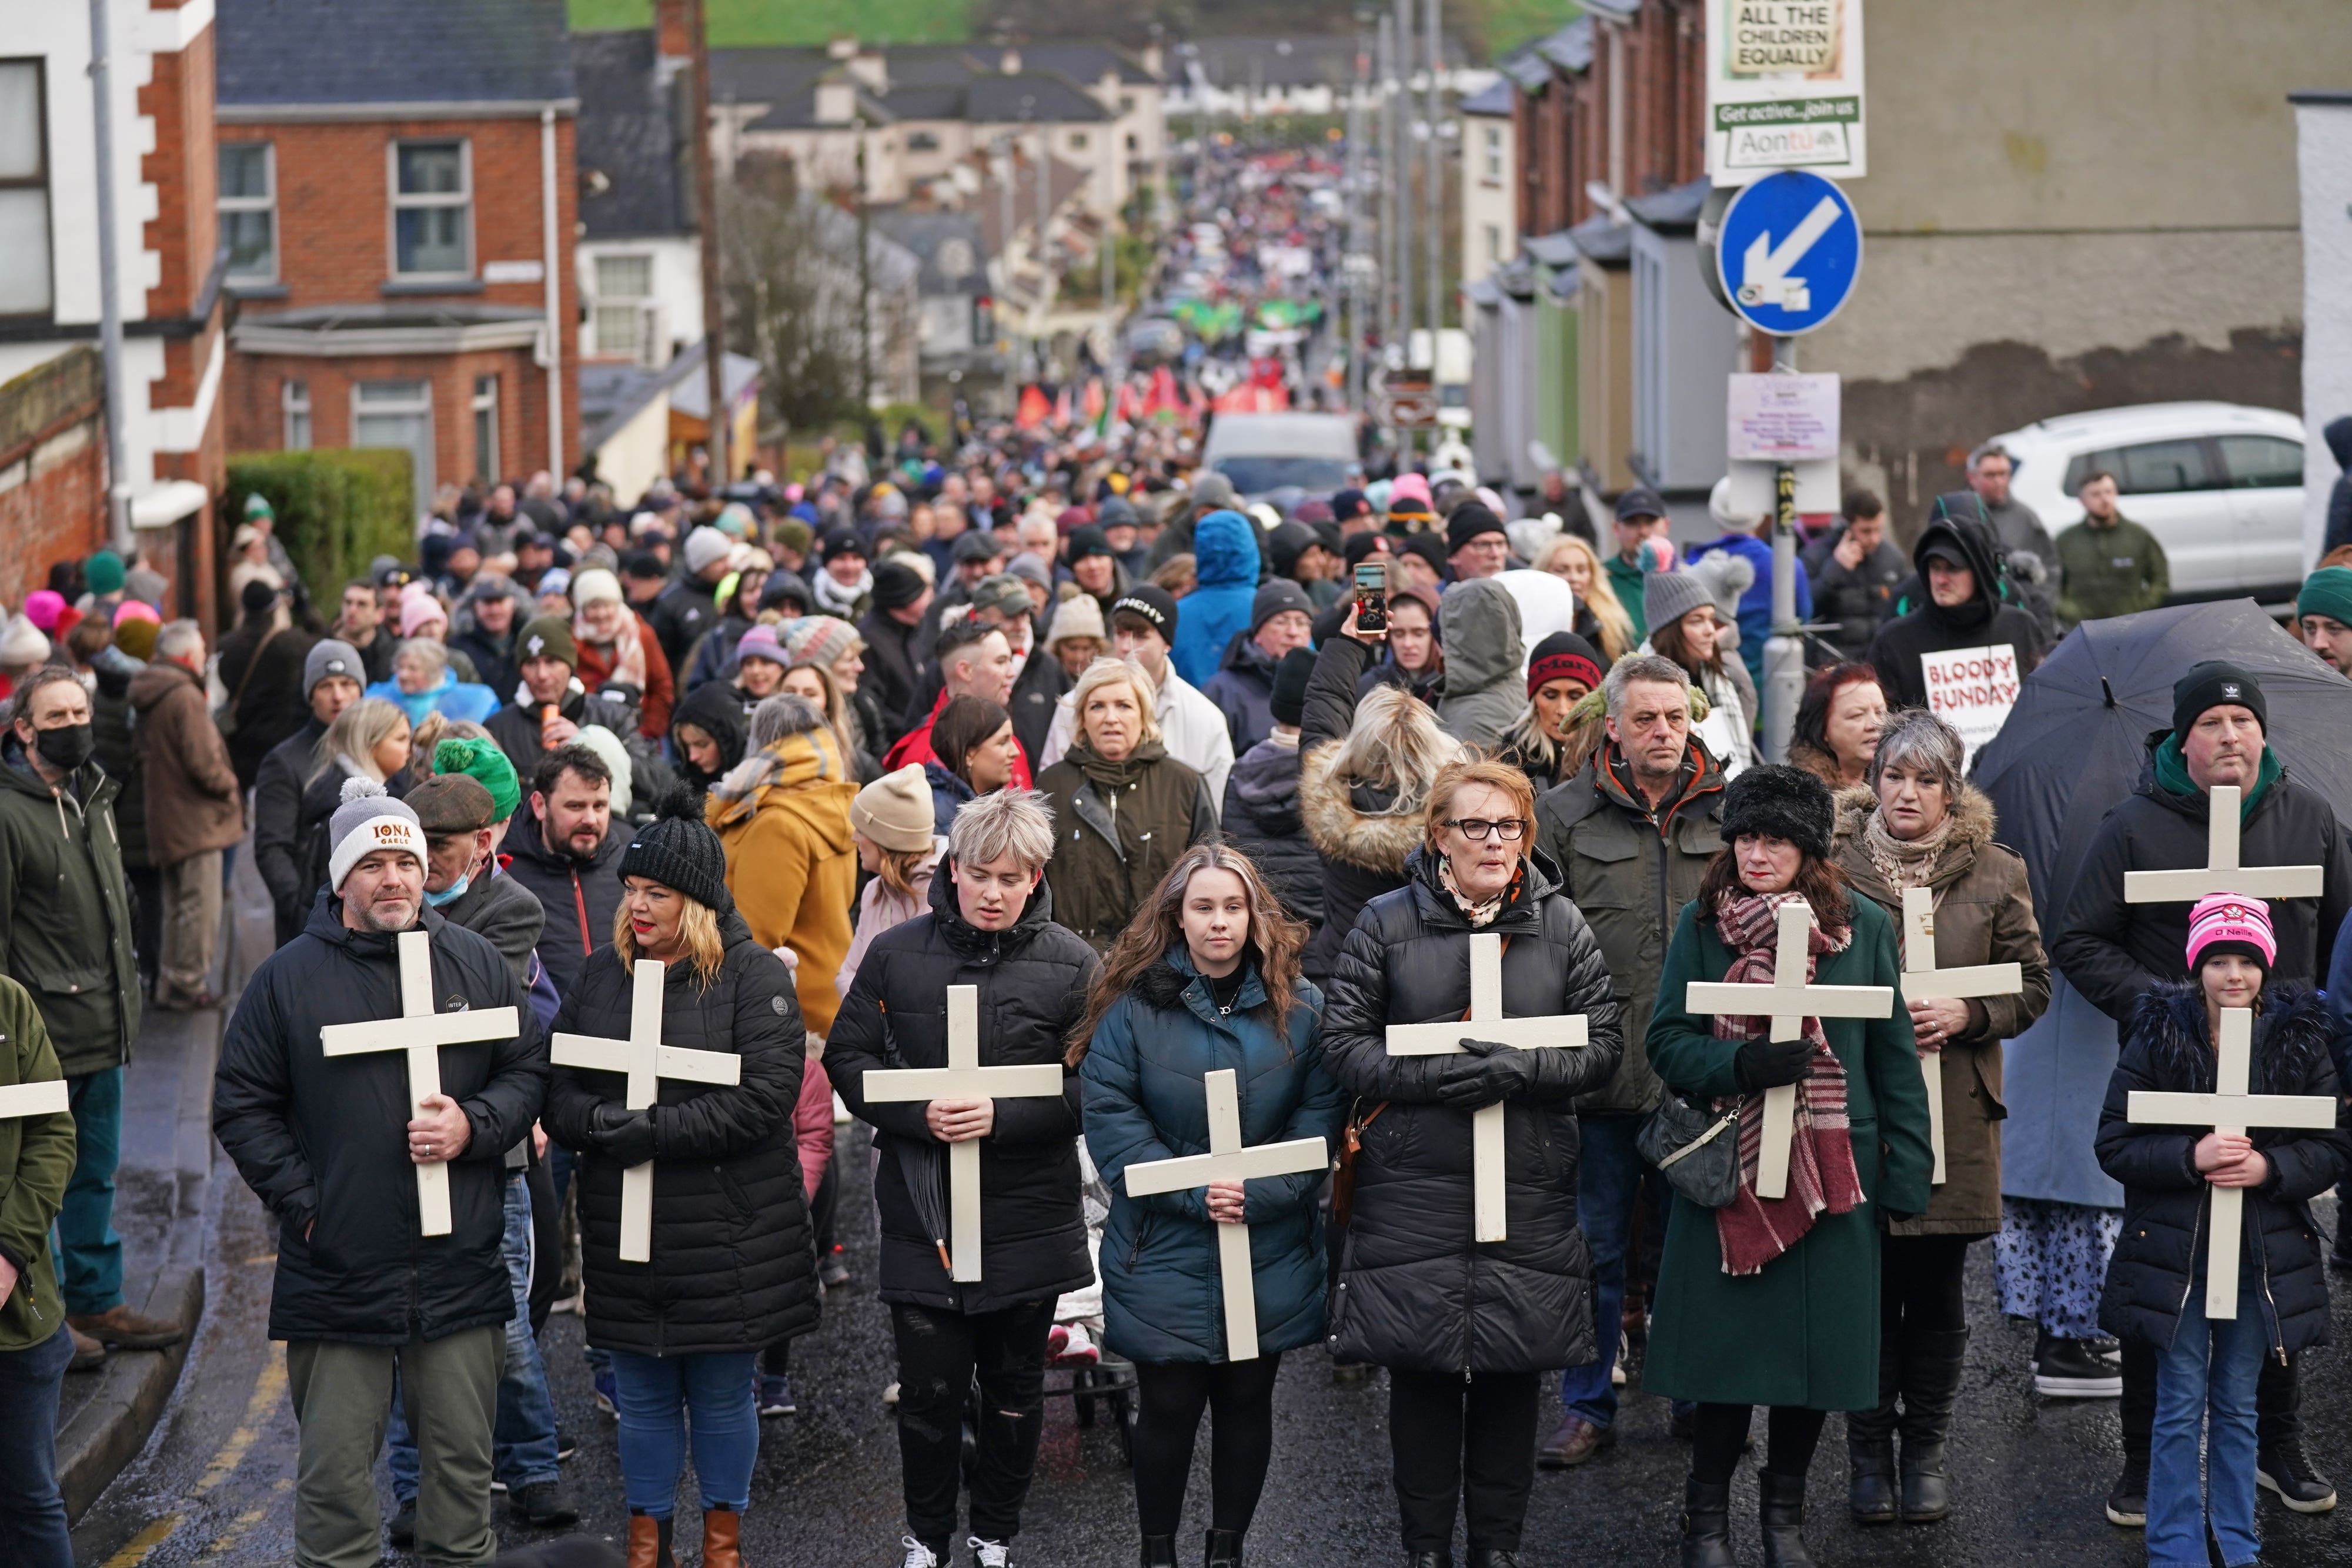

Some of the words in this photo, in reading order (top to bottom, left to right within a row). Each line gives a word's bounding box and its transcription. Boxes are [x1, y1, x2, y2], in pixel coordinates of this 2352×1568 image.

[1739, 6, 1779, 24] ALL
[1785, 6, 1828, 24] THE
[1738, 29, 1828, 44] CHILDREN
[1739, 48, 1828, 65] EQUALLY
[1719, 105, 1747, 122] Get
[1836, 101, 1855, 115] us
[1929, 656, 2012, 684] BLOODY
[1932, 682, 2017, 710] SUNDAY
[1958, 723, 2000, 734] Amnest
[373, 824, 411, 838] IONA
